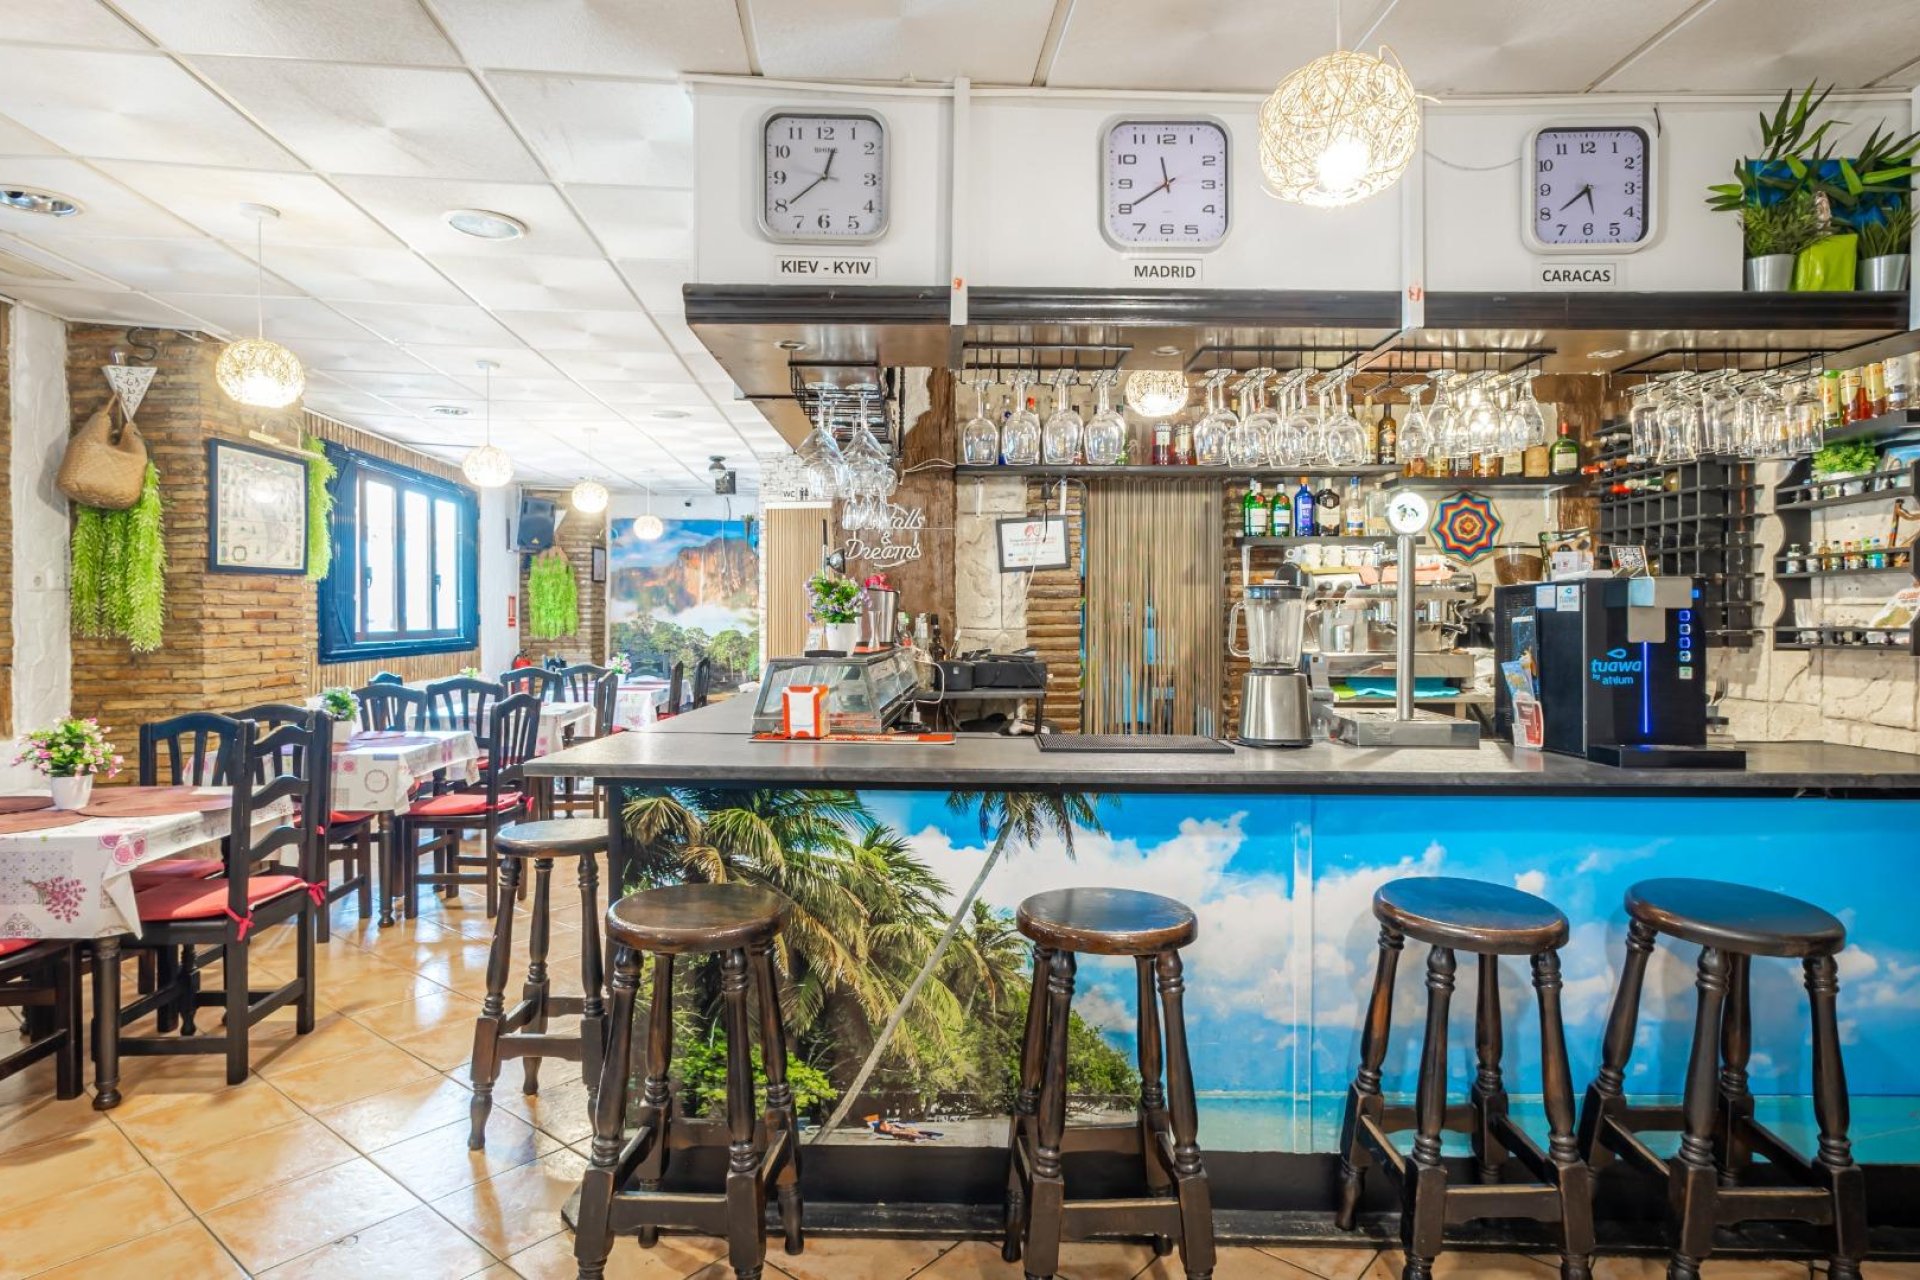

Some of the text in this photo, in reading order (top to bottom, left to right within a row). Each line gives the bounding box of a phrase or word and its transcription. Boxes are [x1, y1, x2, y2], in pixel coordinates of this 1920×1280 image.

[789, 127, 802, 140] 11
[816, 127, 834, 140] 12
[851, 127, 856, 140] 1
[1133, 134, 1145, 144] 11
[1157, 134, 1177, 144] 12
[1190, 134, 1193, 144] 1
[775, 145, 790, 158] 10
[864, 142, 875, 155] 2
[1556, 143, 1568, 155] 11
[1580, 141, 1596, 154] 12
[1612, 142, 1619, 154] 1
[1118, 154, 1137, 165] 10
[1202, 155, 1216, 166] 2
[1539, 159, 1553, 172] 10
[1624, 157, 1635, 170] 2
[774, 171, 786, 184] 9
[864, 173, 877, 186] 3
[1118, 179, 1132, 189] 9
[1201, 180, 1216, 189] 3
[1540, 183, 1551, 196] 9
[1624, 181, 1635, 195] 3
[774, 199, 788, 212] 8
[862, 200, 875, 213] 4
[1118, 203, 1132, 214] 8
[1202, 204, 1216, 214] 4
[1623, 206, 1634, 217] 4
[1540, 207, 1551, 221] 8
[792, 215, 804, 229] 7
[817, 214, 830, 229] 6
[848, 215, 859, 229] 5
[1132, 223, 1146, 234] 7
[1160, 224, 1174, 234] 6
[1184, 224, 1198, 234] 5
[1556, 223, 1568, 236] 7
[1583, 222, 1594, 236] 6
[1609, 222, 1621, 236] 5
[781, 260, 819, 273] KIEV
[833, 261, 871, 274] KYIV
[1134, 265, 1196, 278] MADRID
[1542, 269, 1611, 282] CARACAS
[783, 490, 796, 498] WC
[885, 503, 926, 530] Falls
[881, 530, 892, 544] &
[845, 539, 922, 560] Dreams
[1591, 659, 1643, 673] tuawa
